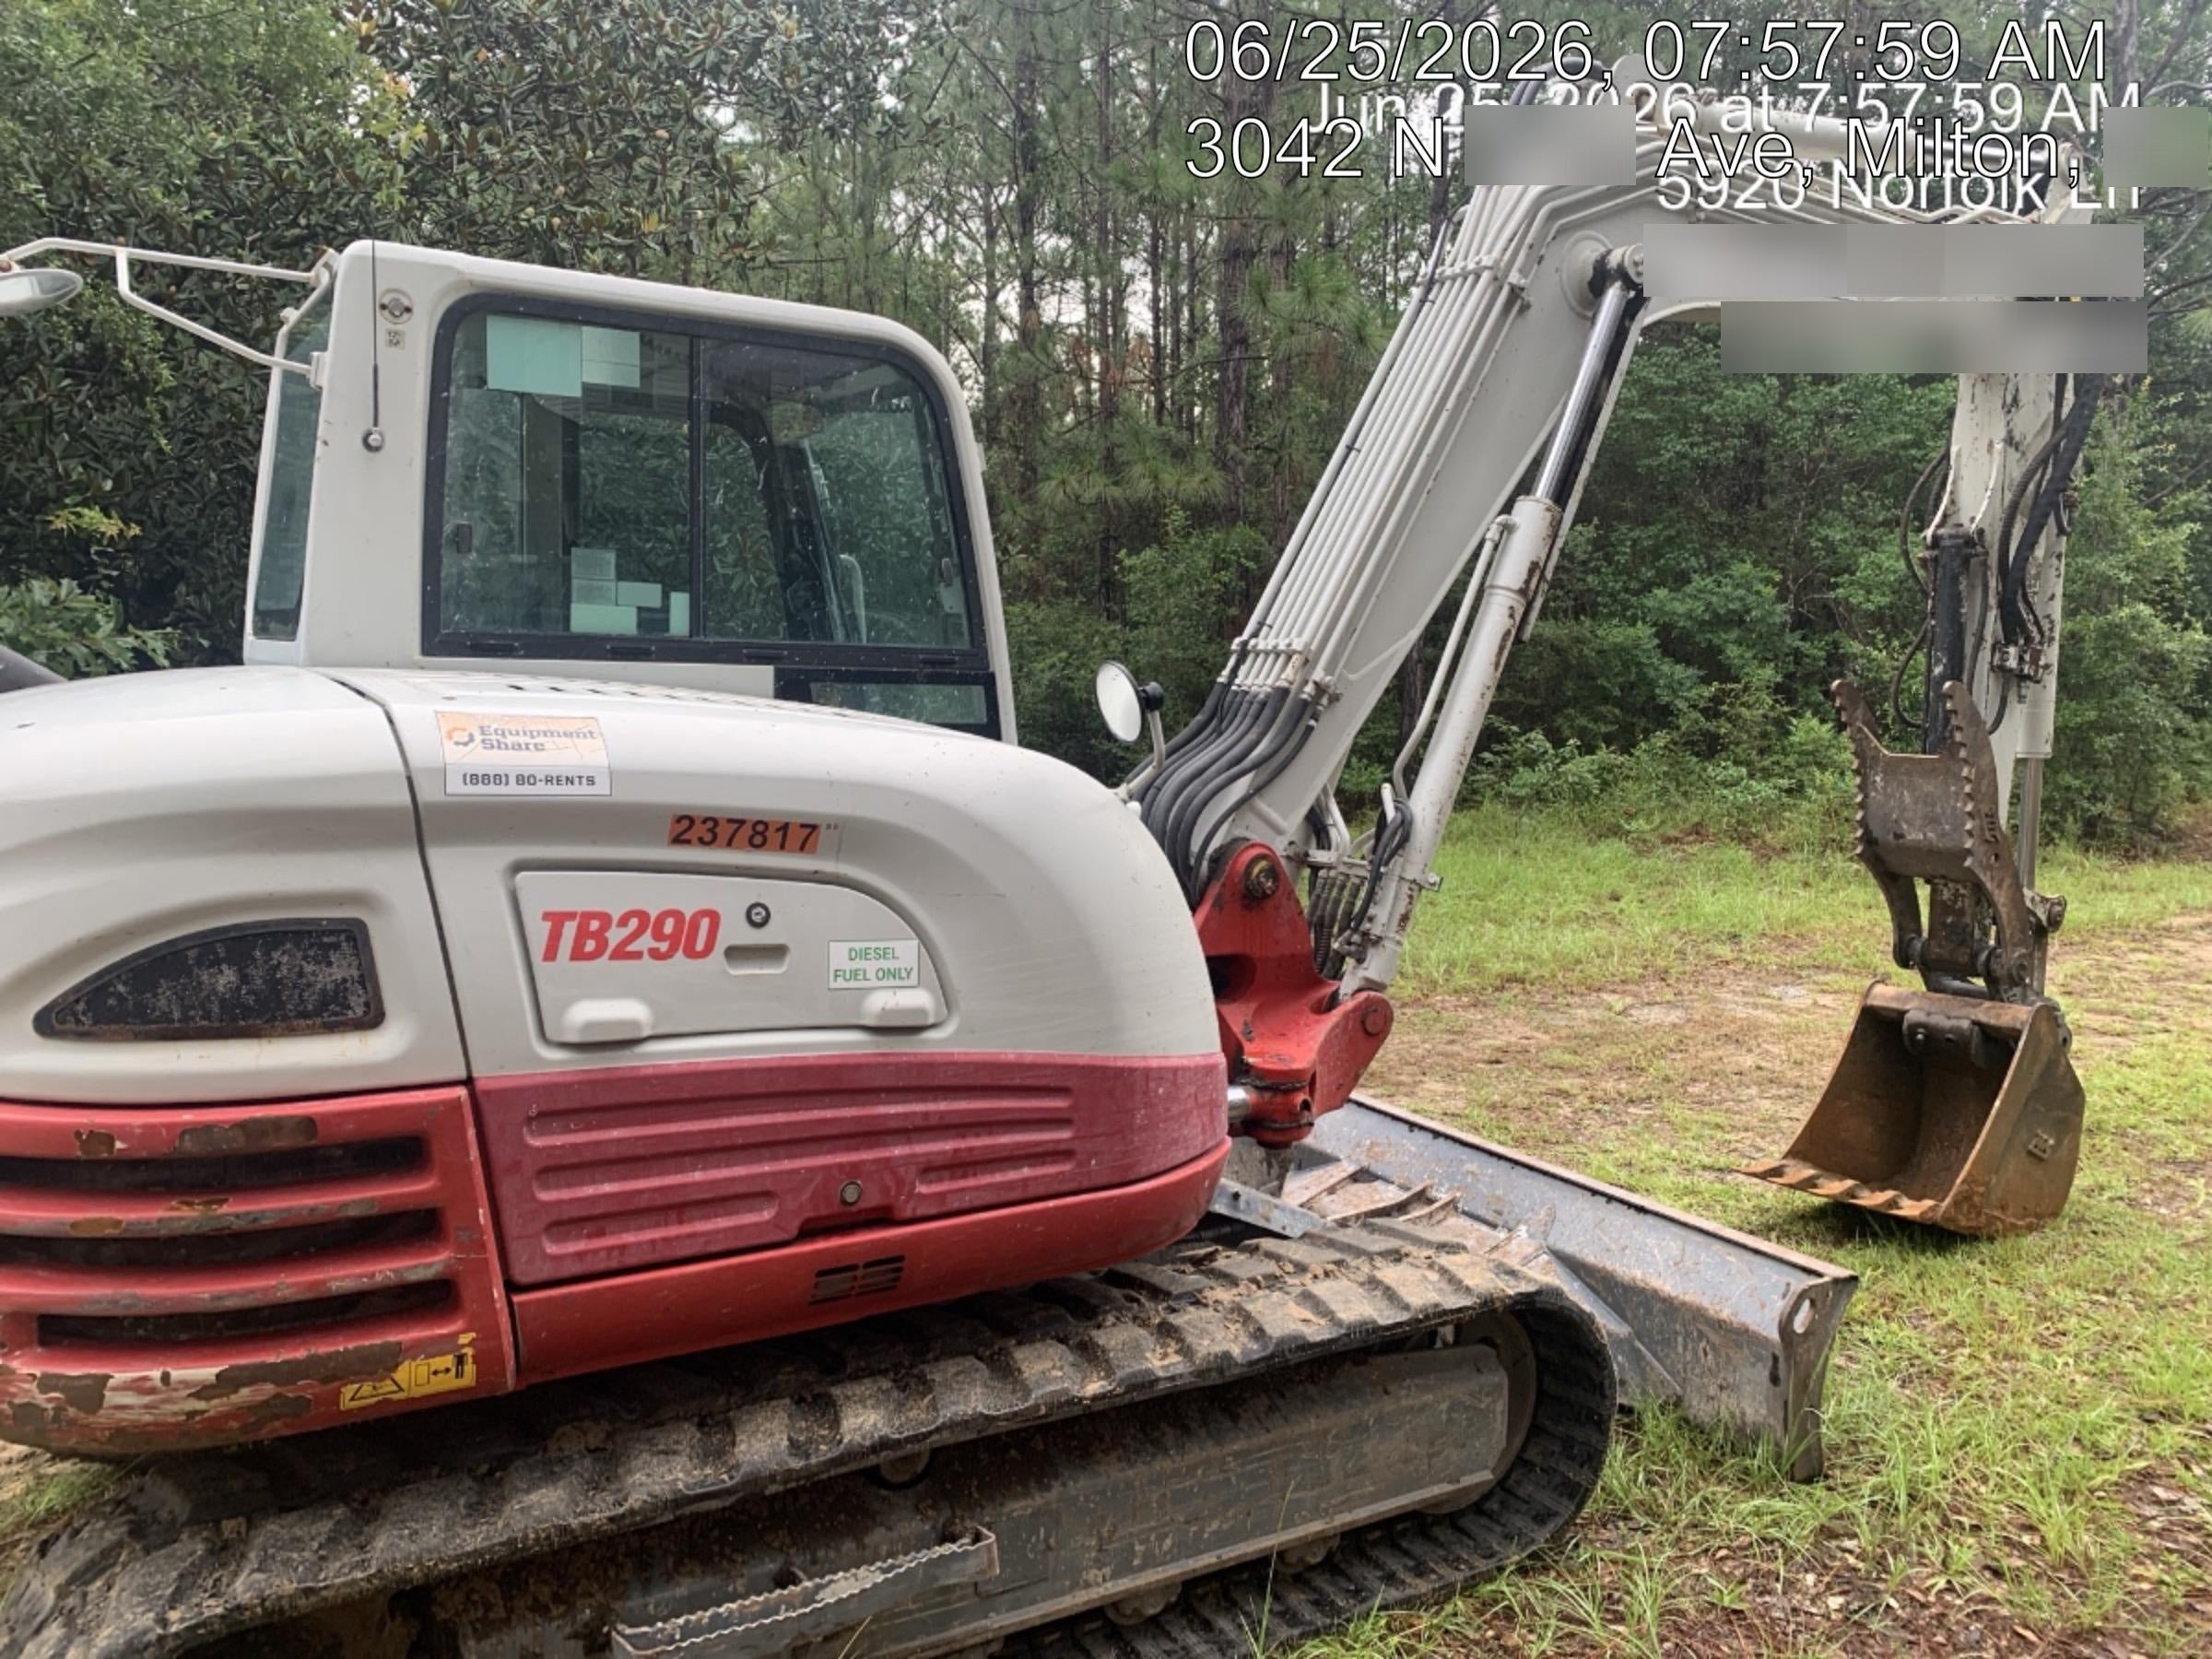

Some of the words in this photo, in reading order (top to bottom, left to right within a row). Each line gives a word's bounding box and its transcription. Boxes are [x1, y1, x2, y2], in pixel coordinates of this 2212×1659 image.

[478, 725, 597, 739] Equipment
[481, 738, 546, 751] Share
[671, 814, 819, 852] 237817
[541, 909, 722, 962] TB290
[848, 947, 900, 960] DIESEL
[833, 969, 870, 982] FUEL
[876, 967, 913, 981] ONLY
